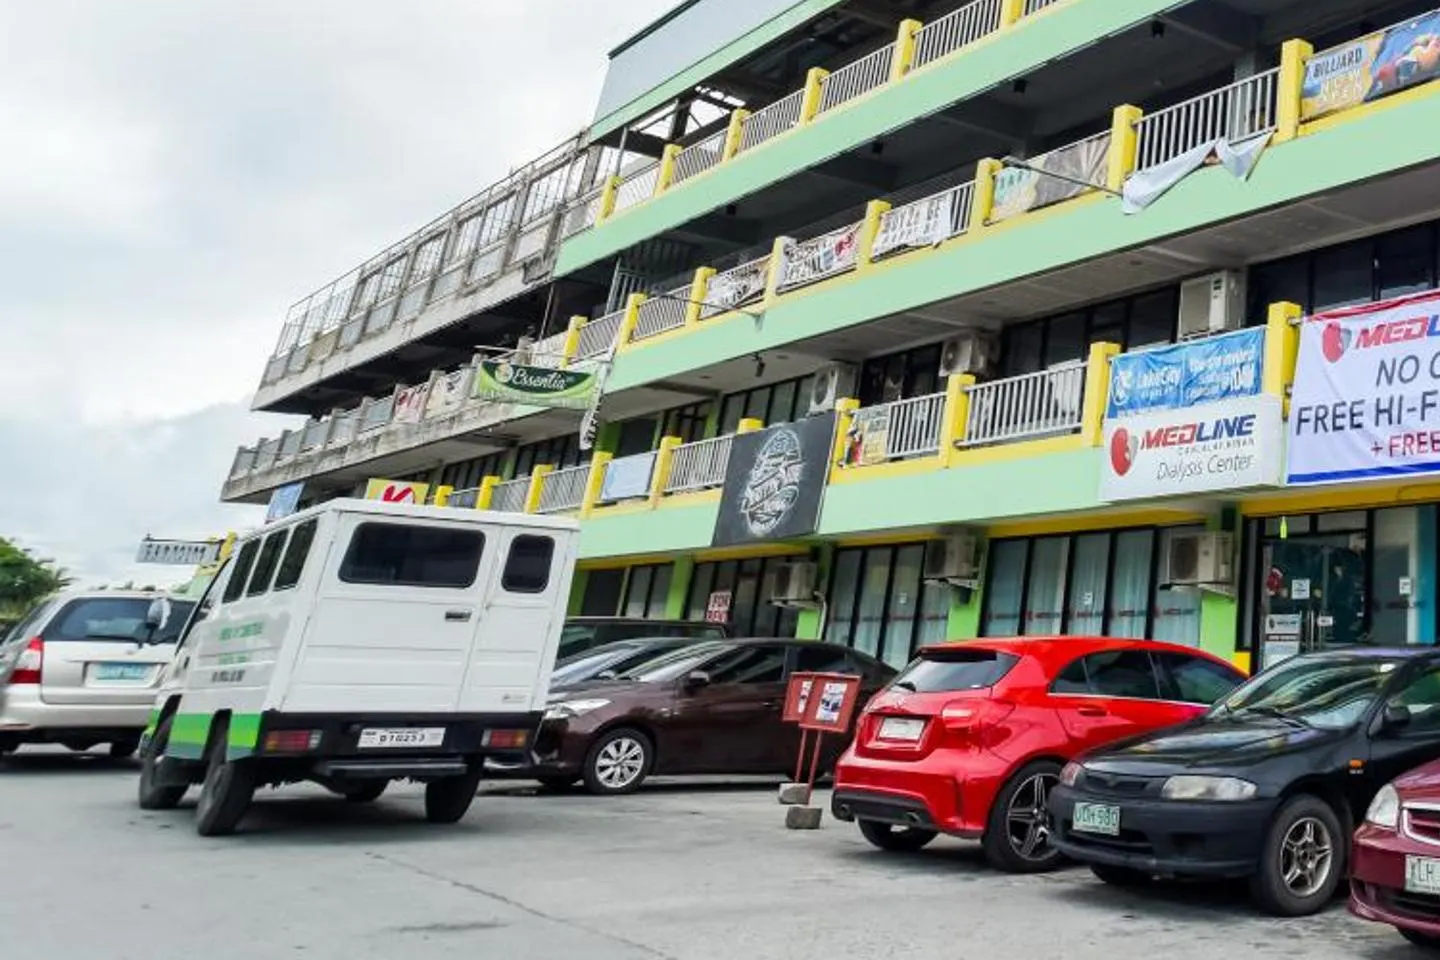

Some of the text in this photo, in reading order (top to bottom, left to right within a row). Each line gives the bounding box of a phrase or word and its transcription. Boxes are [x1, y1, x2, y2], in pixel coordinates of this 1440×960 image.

[1313, 47, 1363, 78] BILLIARD
[1375, 356, 1419, 387] NO
[1141, 414, 1257, 450] MEDLINE
[1296, 400, 1364, 436] FREE
[1157, 454, 1255, 482] Dialysis Center
